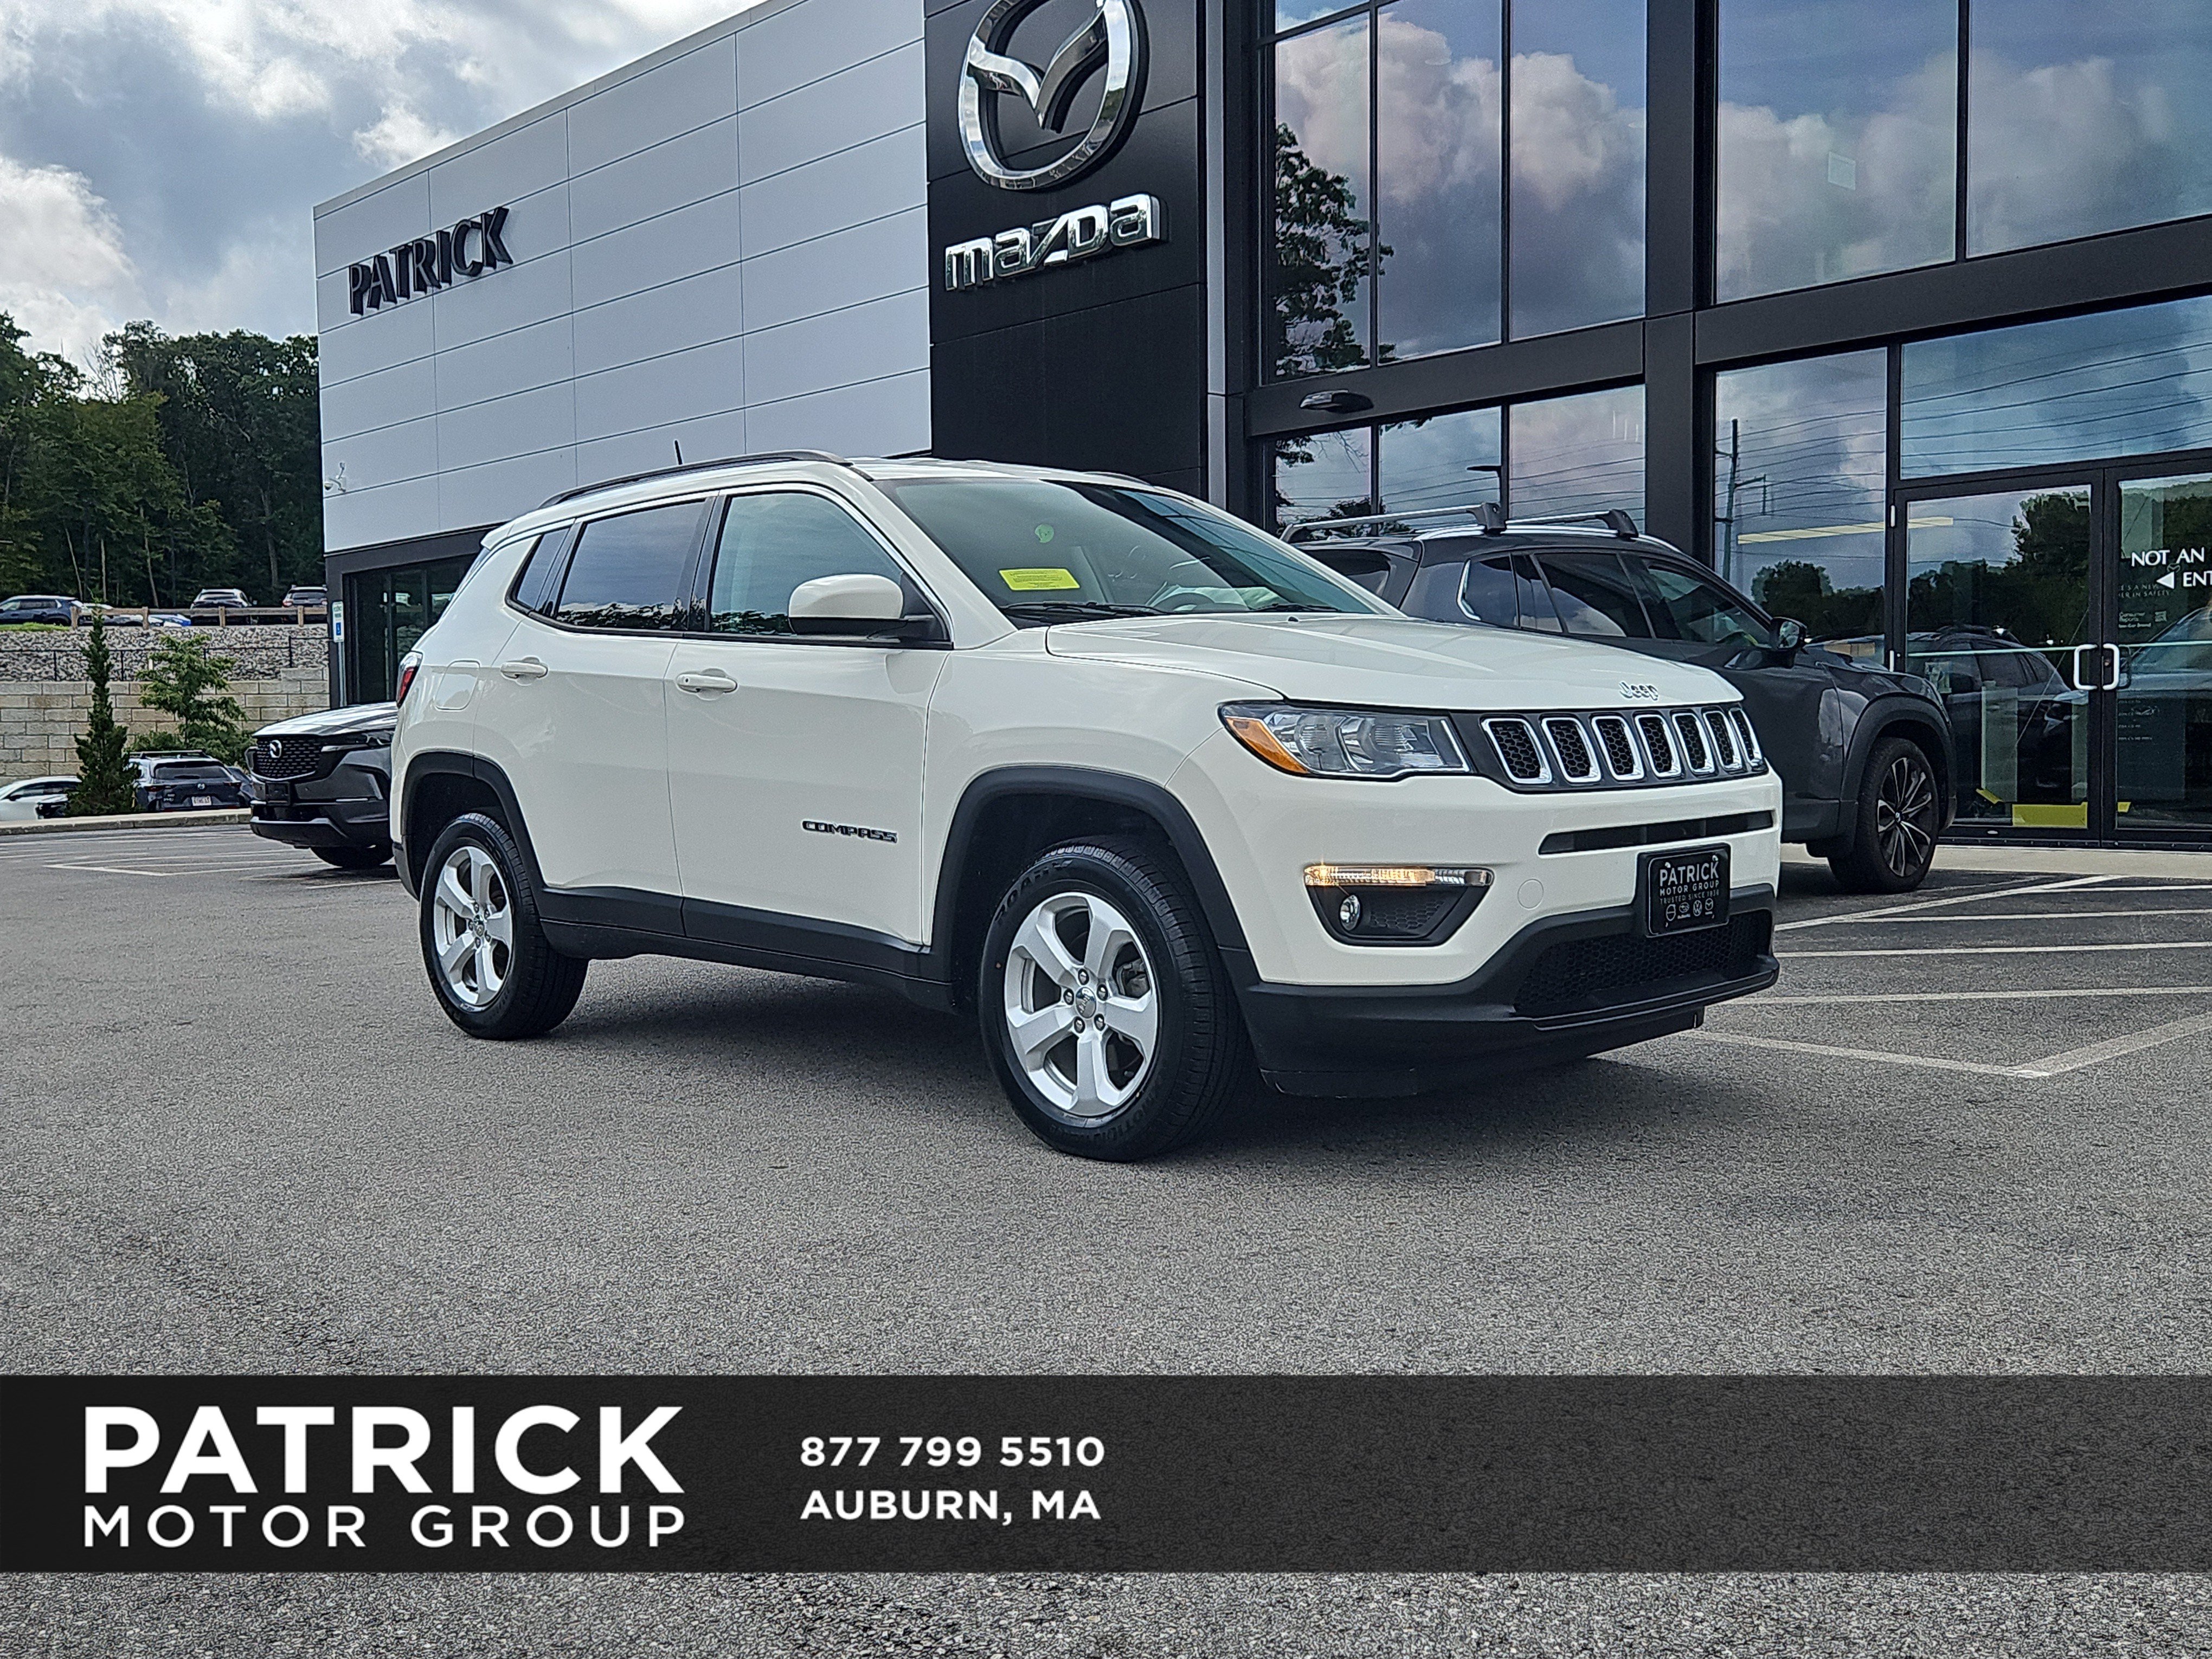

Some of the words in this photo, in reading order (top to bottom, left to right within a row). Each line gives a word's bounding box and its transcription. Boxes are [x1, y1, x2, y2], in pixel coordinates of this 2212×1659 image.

[349, 207, 513, 315] PATRICK
[2131, 549, 2170, 567] NOT
[2176, 546, 2205, 564] AN
[1619, 681, 1659, 702] Jeep
[802, 820, 898, 844] COMPASS
[1660, 861, 1719, 887] PATRICK
[1660, 884, 1688, 897] MOTOR
[1693, 879, 1720, 891] GROUP
[1660, 895, 1686, 905] TRUSTED
[1688, 891, 1705, 901] SINCE
